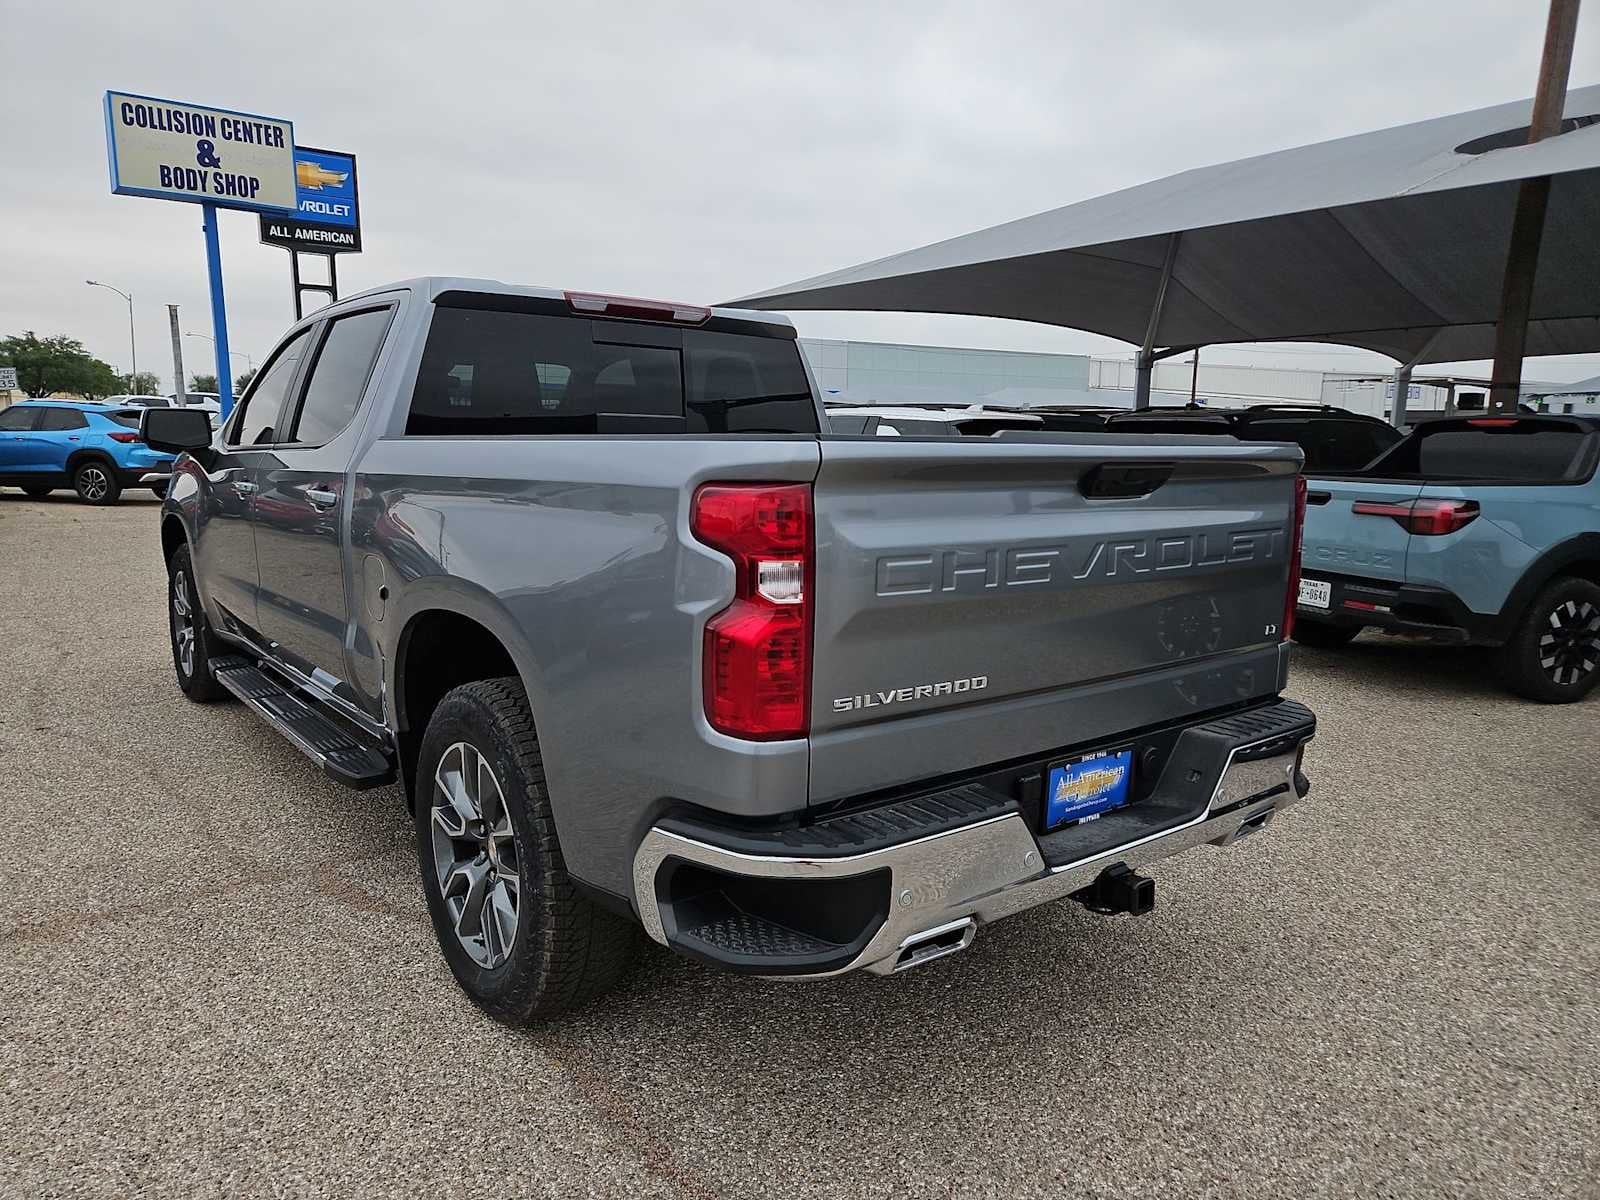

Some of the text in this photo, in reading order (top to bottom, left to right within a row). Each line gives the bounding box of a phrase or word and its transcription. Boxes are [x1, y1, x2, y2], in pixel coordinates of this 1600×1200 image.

[121, 103, 284, 148] COLLISION CENTER
[196, 139, 221, 169] &
[160, 165, 260, 199] BODY SHOP
[299, 200, 351, 217] VROLET
[269, 225, 354, 245] ALL AMERICAN
[0, 380, 15, 388] 35
[876, 527, 1285, 598] CHEVROLET
[832, 675, 989, 713] SILVERADO
[1057, 765, 1125, 790] All American
